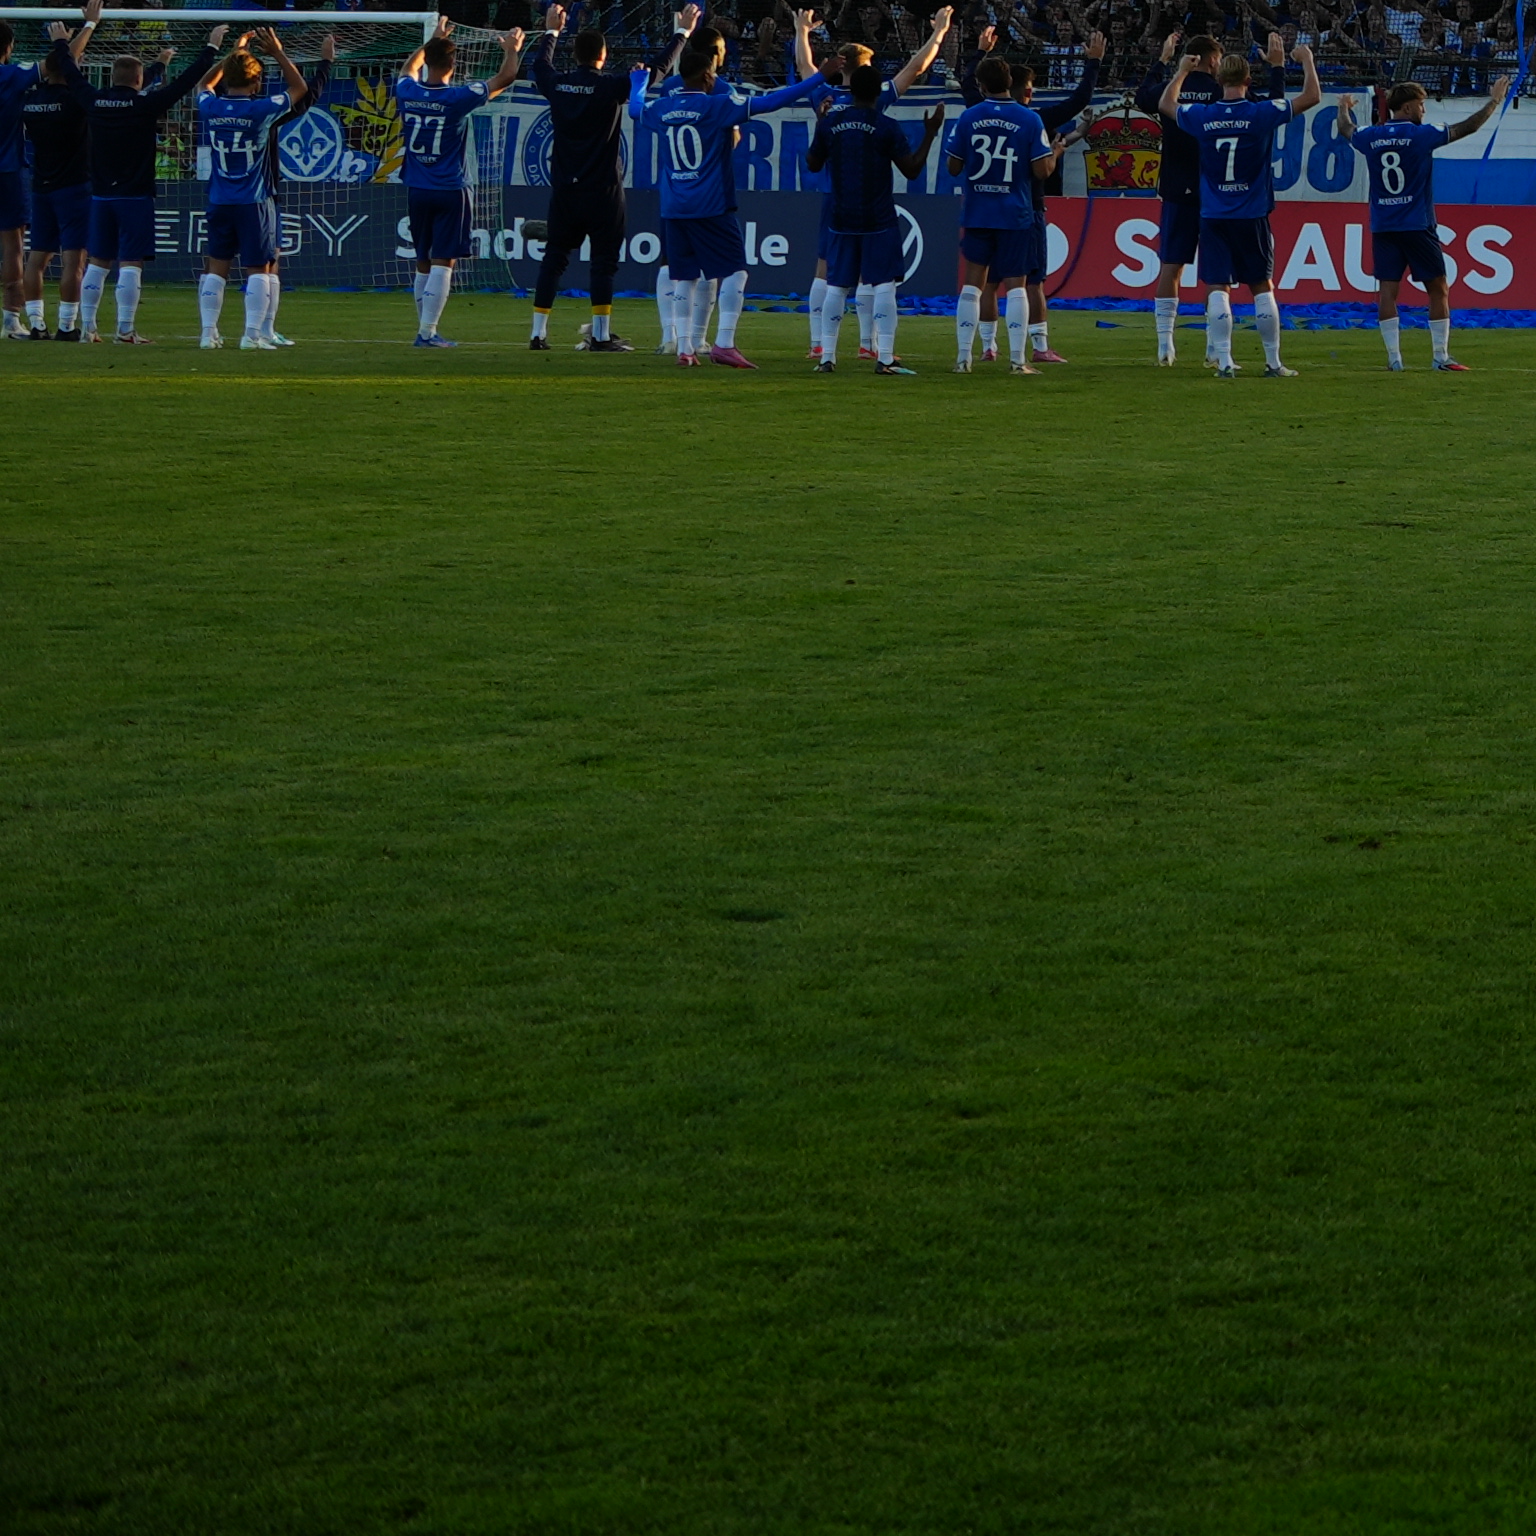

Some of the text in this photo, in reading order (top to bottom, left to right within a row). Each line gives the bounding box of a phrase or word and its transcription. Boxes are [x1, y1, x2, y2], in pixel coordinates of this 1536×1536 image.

[404, 113, 447, 156] 27
[665, 124, 703, 171] 10
[830, 121, 877, 136] DARMSTADT
[971, 118, 1022, 134] DARMSTADT
[1202, 120, 1252, 132] DARMSTADT
[1369, 137, 1413, 151] DARMSTADT
[209, 130, 258, 178] 44
[967, 134, 1019, 183] 34
[1214, 137, 1240, 183] 7
[1380, 151, 1406, 195] 8
